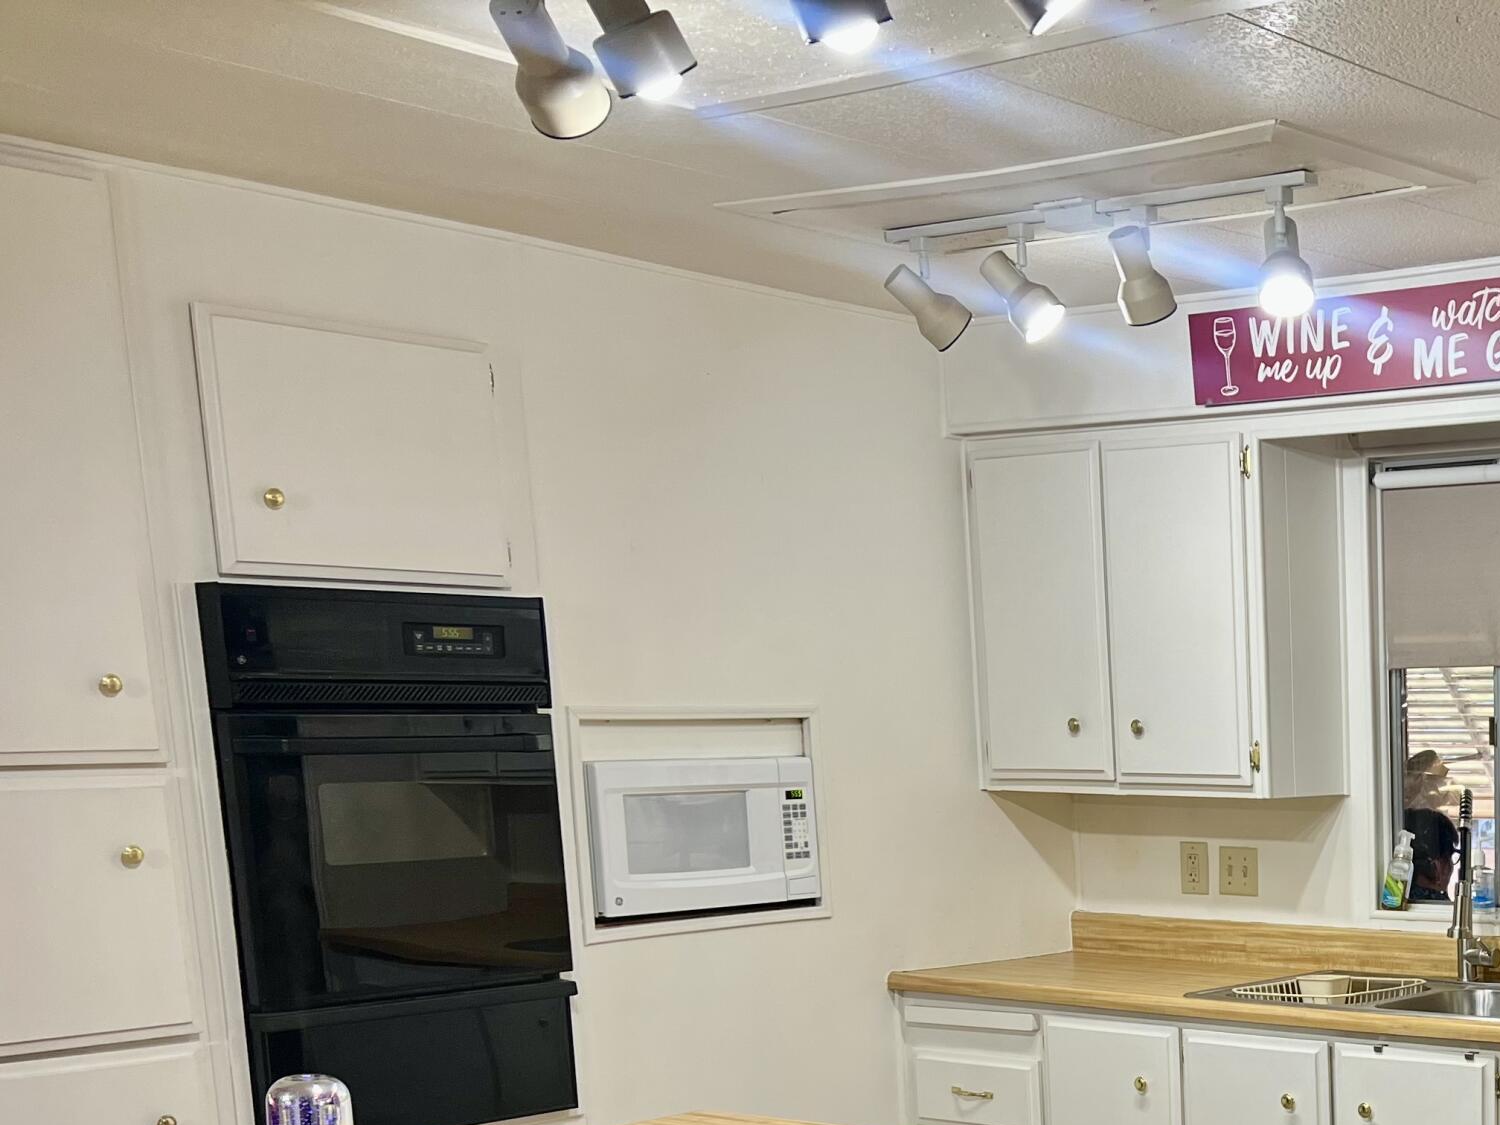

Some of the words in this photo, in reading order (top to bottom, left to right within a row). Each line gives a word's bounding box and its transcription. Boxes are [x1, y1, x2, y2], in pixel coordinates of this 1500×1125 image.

[1248, 307, 1352, 358] WINE
[1367, 306, 1394, 376] &
[1413, 332, 1469, 380] ME
[1257, 357, 1299, 383] me
[1305, 356, 1343, 389] up
